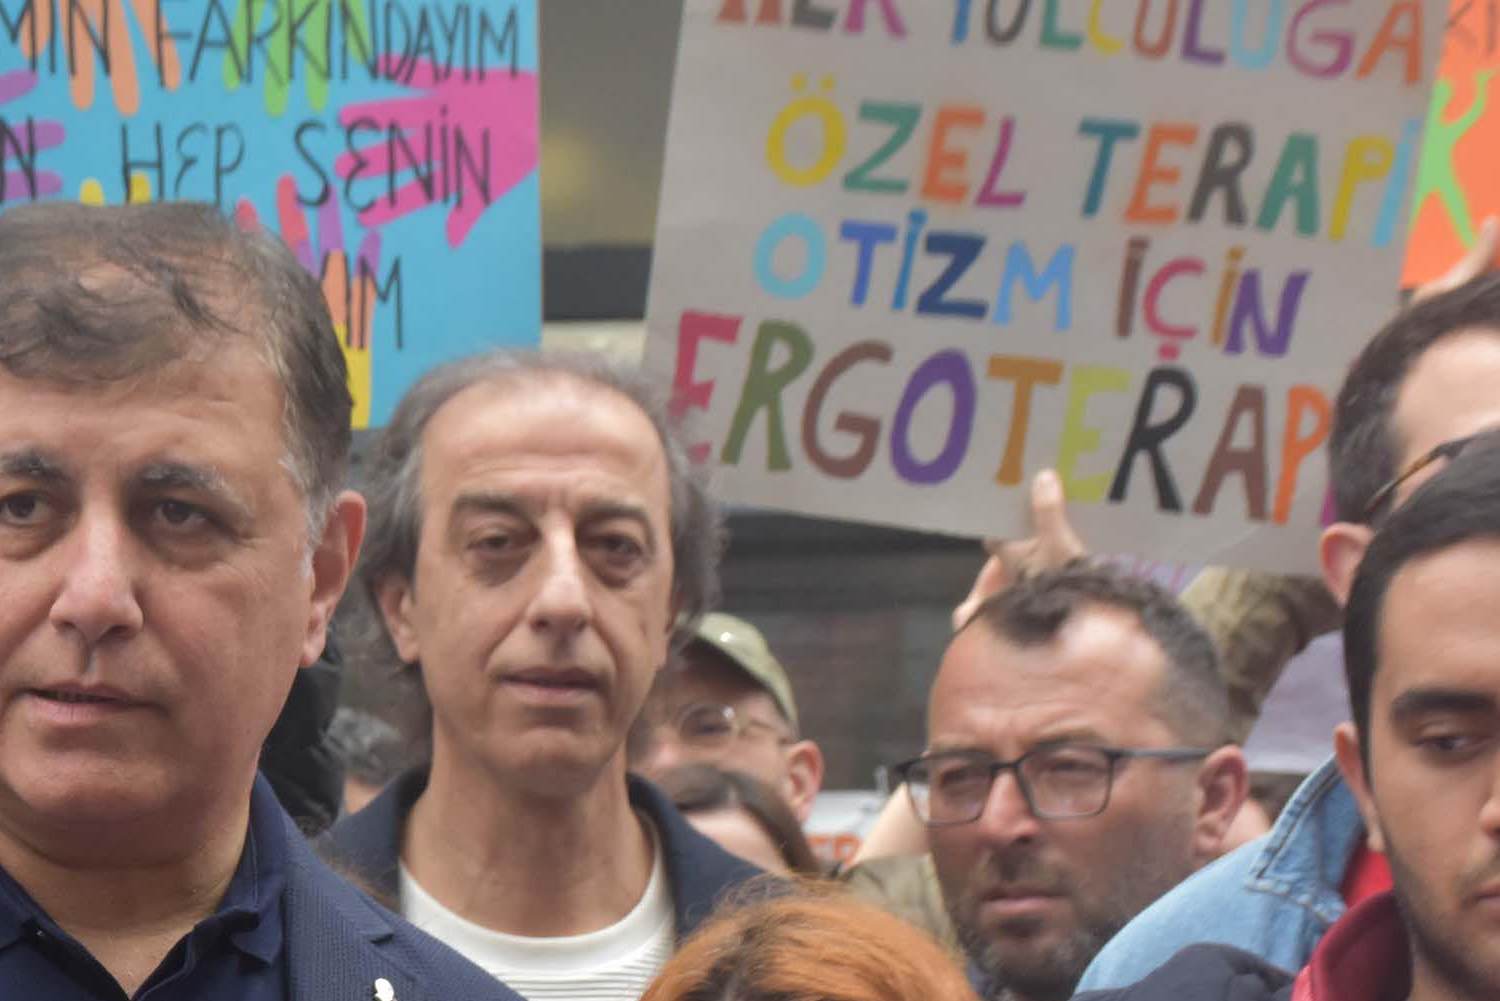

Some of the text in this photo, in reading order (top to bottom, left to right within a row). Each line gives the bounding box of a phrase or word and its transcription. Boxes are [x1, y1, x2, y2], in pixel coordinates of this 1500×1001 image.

[120, 121, 246, 202] HEP
[294, 106, 492, 212] SENİN
[765, 72, 1423, 249] ÖZEL TERAPİ
[753, 209, 1310, 361] OTİZM İÇİN
[666, 309, 1338, 528] ERGOTERAP
